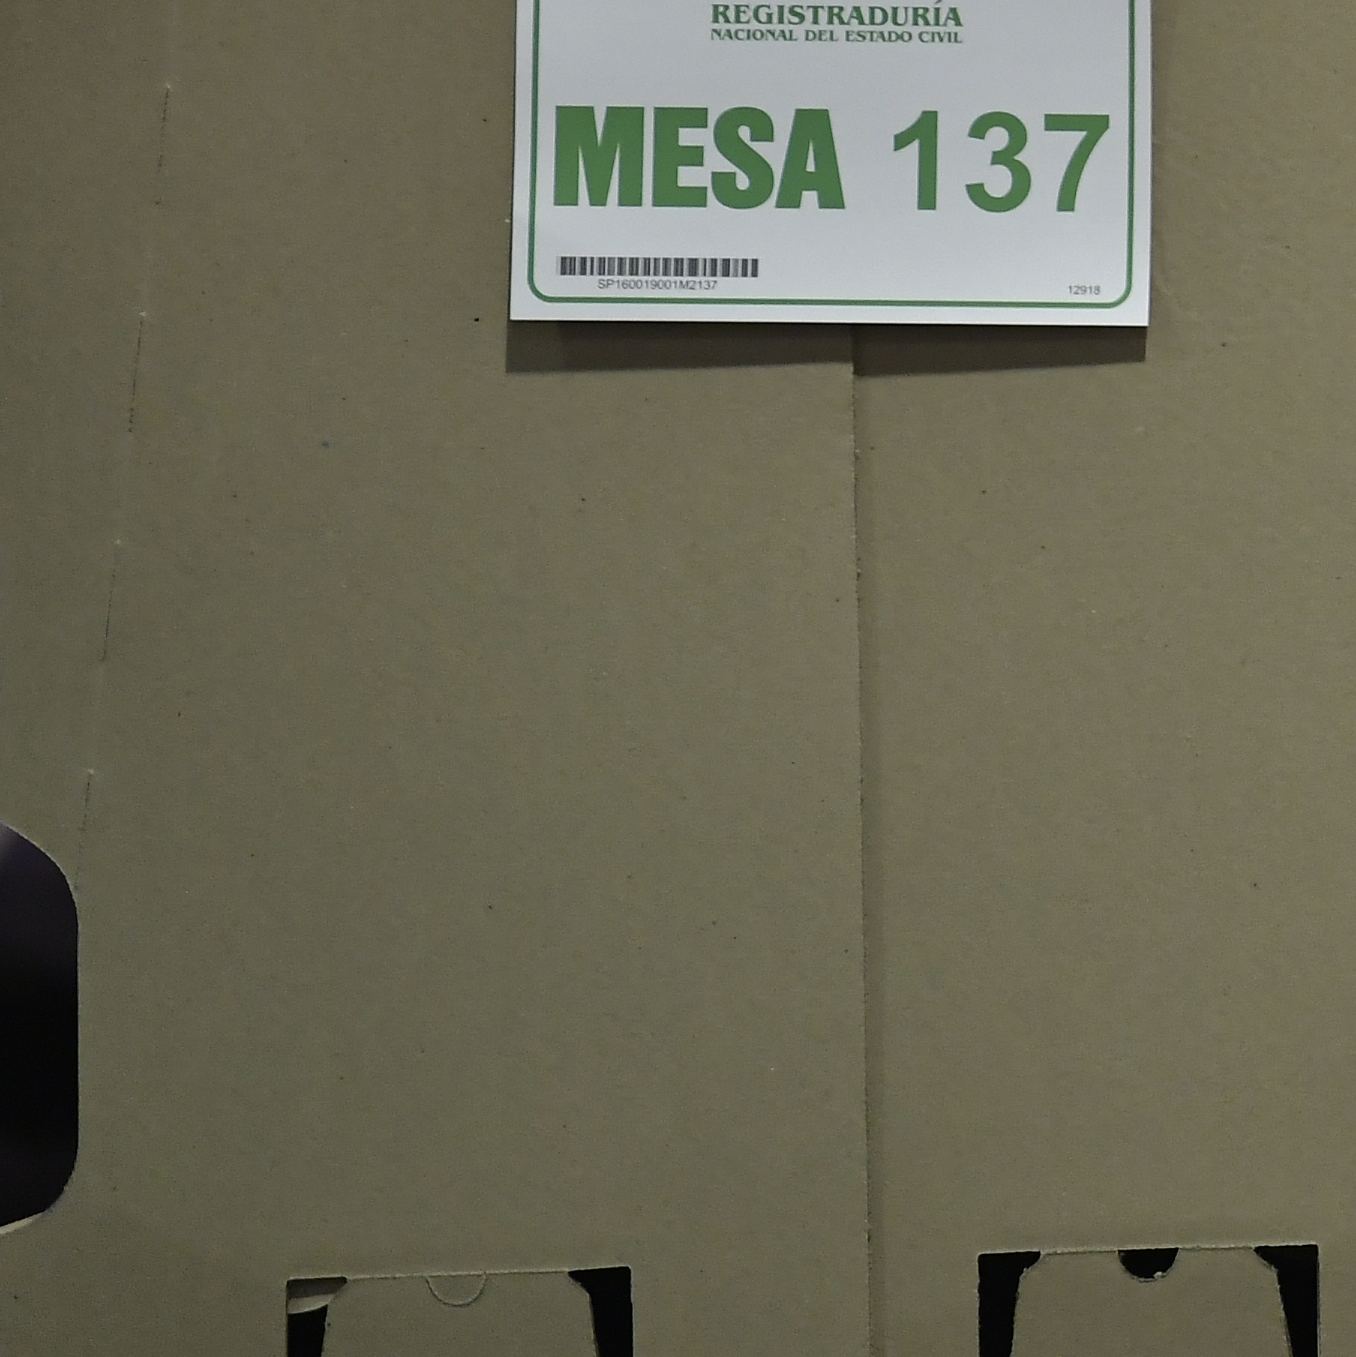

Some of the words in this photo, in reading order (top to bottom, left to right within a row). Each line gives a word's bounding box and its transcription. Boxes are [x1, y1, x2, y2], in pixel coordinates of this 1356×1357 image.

[711, 0, 963, 28] REGISTRADURÍA
[711, 28, 798, 42] NACIONAL
[804, 30, 838, 42] DEL
[845, 30, 913, 43] ESTADO
[918, 31, 963, 44] CIVIL
[553, 105, 846, 210] MESA
[893, 110, 1110, 213] 137
[1068, 285, 1101, 296] 12918
